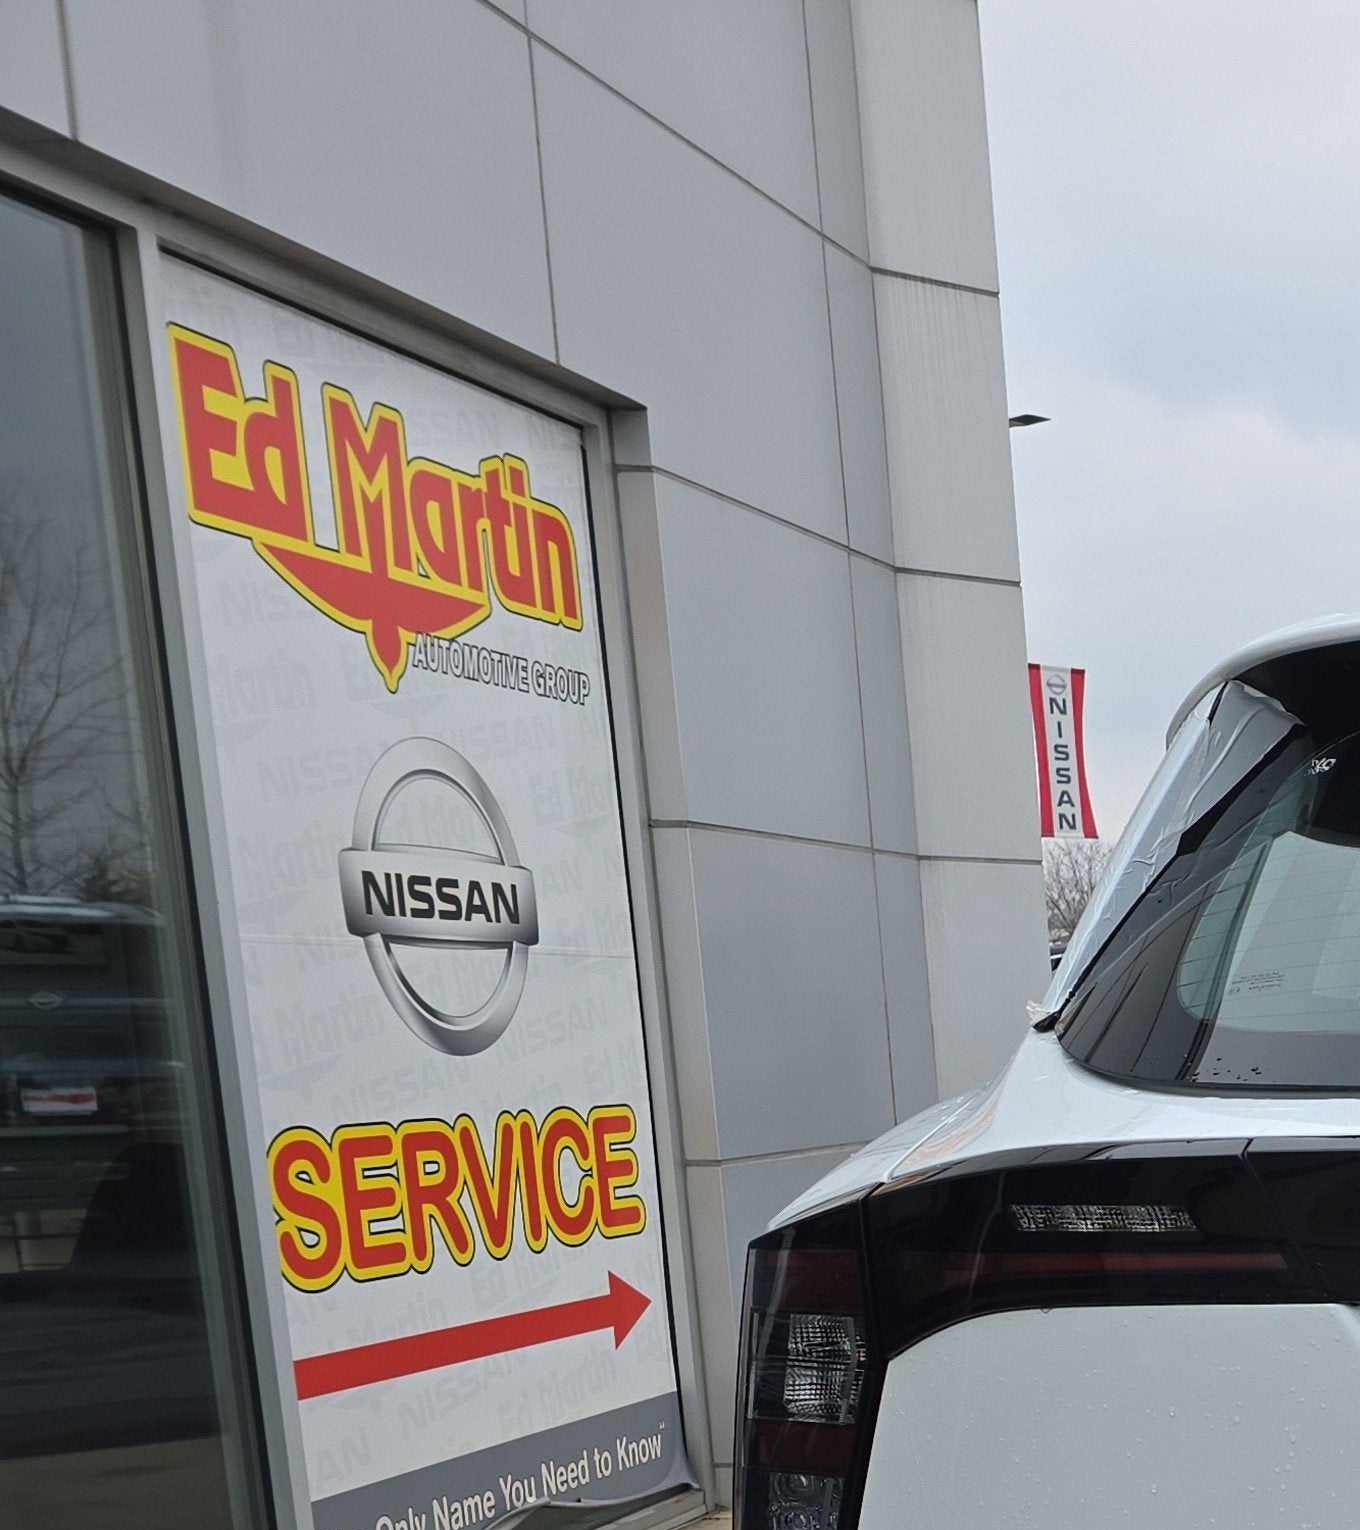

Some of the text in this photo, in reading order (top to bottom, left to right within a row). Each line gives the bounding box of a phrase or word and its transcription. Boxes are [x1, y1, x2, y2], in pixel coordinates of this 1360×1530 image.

[166, 322, 582, 630] Ed Martin
[411, 631, 592, 706] AUTOMOTIVE GROUP
[1049, 696, 1077, 831] NISSAN
[361, 870, 520, 925] NISSAN
[268, 1106, 645, 1290] SERVICE
[499, 1474, 537, 1511] You
[541, 1449, 589, 1497] Need
[593, 1447, 612, 1478] to
